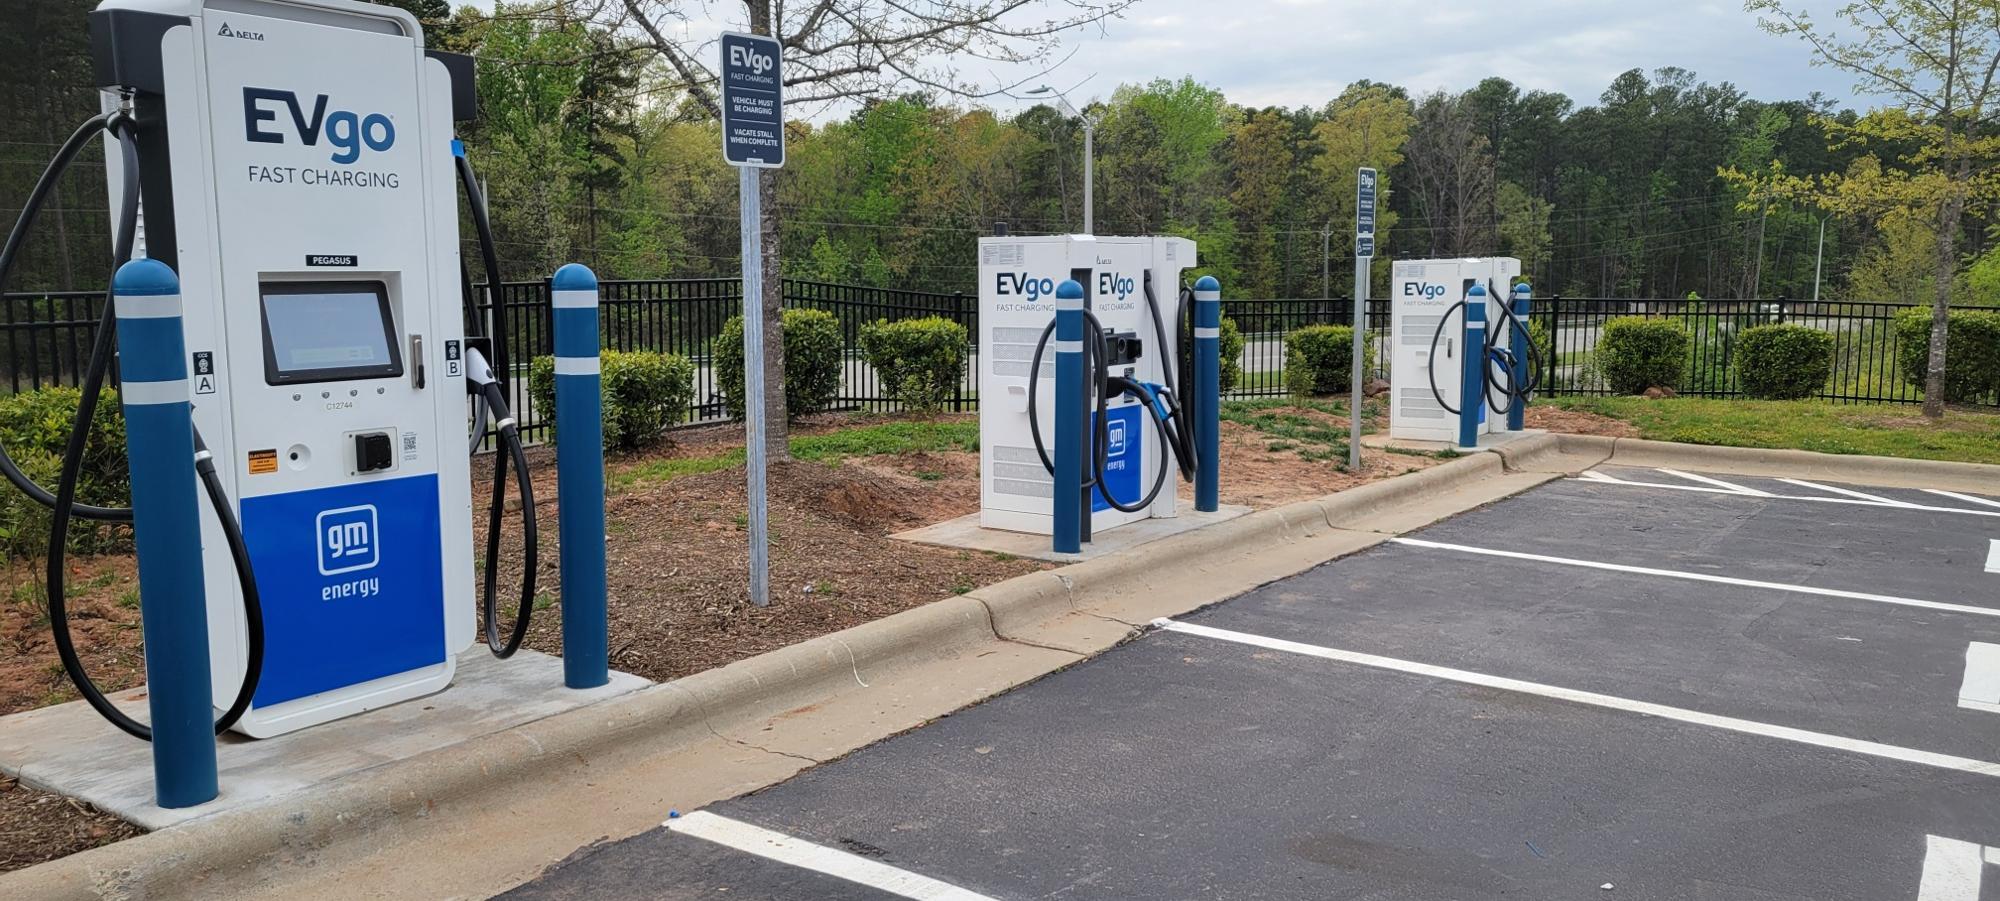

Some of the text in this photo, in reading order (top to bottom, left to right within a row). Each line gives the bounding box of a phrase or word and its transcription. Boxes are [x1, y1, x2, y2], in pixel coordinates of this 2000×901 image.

[236, 30, 264, 41] DELTA
[730, 45, 773, 75] EVgo
[731, 72, 774, 84] FAST CHARGING
[732, 96, 774, 107] VEHICLE MUST
[742, 105, 773, 115] CHARGING
[243, 87, 395, 165] EVgo
[734, 128, 774, 138] VACATE STALL
[730, 136, 778, 147] WHEN COMPLETE
[248, 166, 399, 188] FAST CHARGING
[1361, 174, 1374, 188] EVgo
[312, 256, 351, 265] PEGASUS
[996, 272, 1054, 301] EVgo
[1100, 272, 1134, 300] EVgo
[1404, 282, 1446, 300] EVgo
[1016, 304, 1055, 312] CHARGING
[1111, 303, 1135, 312] CHARGING
[449, 361, 458, 374] B
[200, 376, 211, 391] A
[1110, 428, 1123, 448] gm
[1107, 460, 1126, 471] energy
[328, 521, 368, 558] gm
[322, 577, 379, 601] energy
